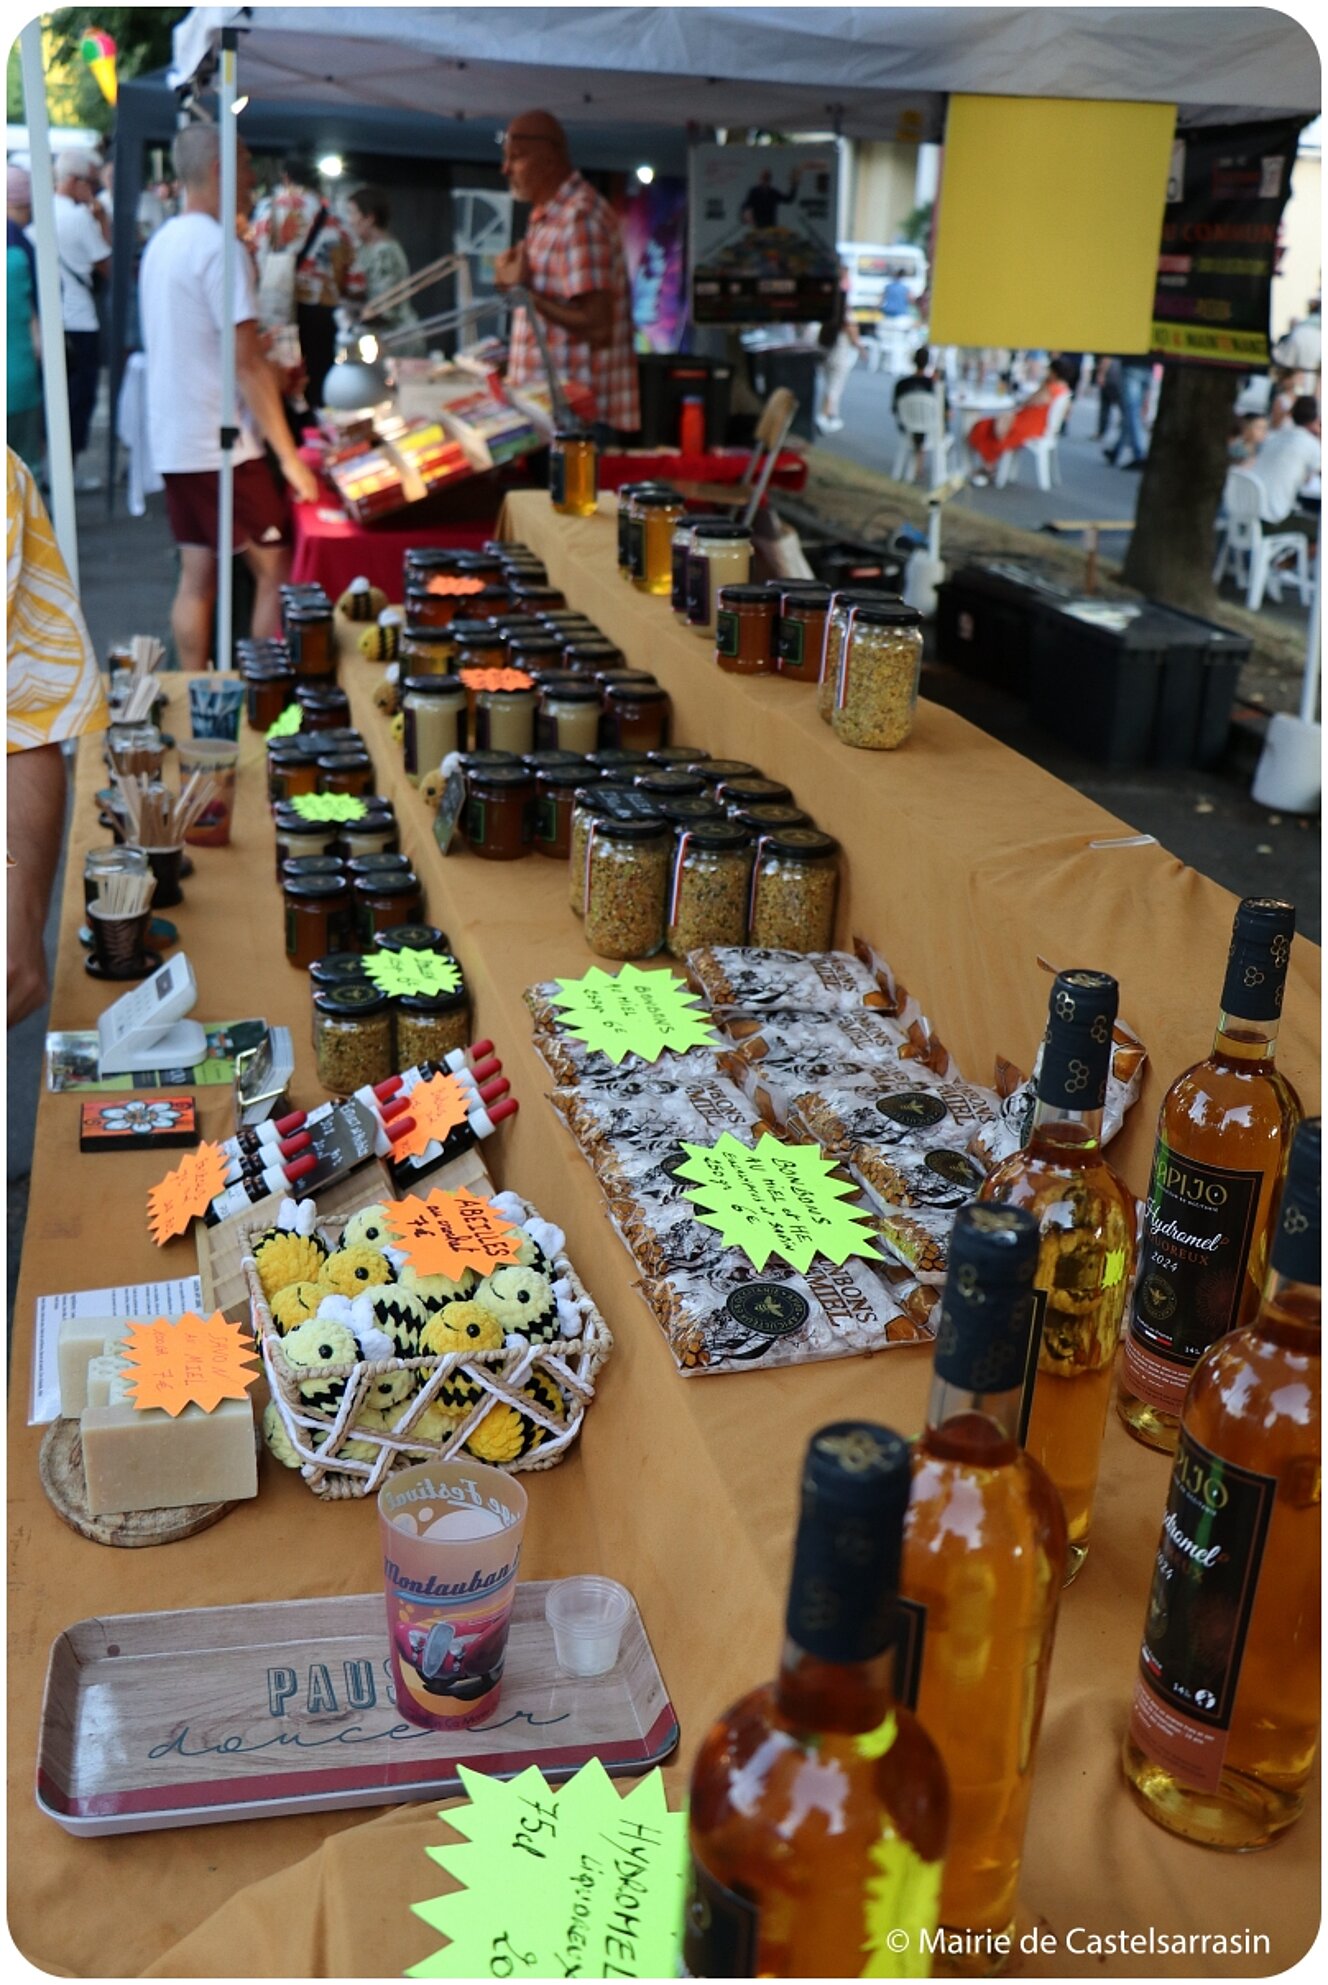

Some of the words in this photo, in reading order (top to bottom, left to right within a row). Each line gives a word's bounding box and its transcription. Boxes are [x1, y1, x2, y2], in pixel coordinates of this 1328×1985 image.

[634, 985, 676, 1035] BONBONS
[771, 1157, 832, 1226] BONBONS
[1156, 1161, 1228, 1206] APIJO
[406, 1214, 436, 1238] 7€
[454, 1198, 510, 1257] ABEILLES
[789, 1224, 814, 1244] HE
[1144, 1195, 1223, 1252] Hydromel
[1150, 1251, 1179, 1273] 2024
[808, 1274, 854, 1328] MIEL
[184, 1353, 205, 1388] MIEL
[384, 1554, 510, 1597] Montauban
[147, 1708, 571, 1760] doucer
[512, 1795, 561, 1859] 75cl
[600, 1818, 663, 1978] HYDROMEL
